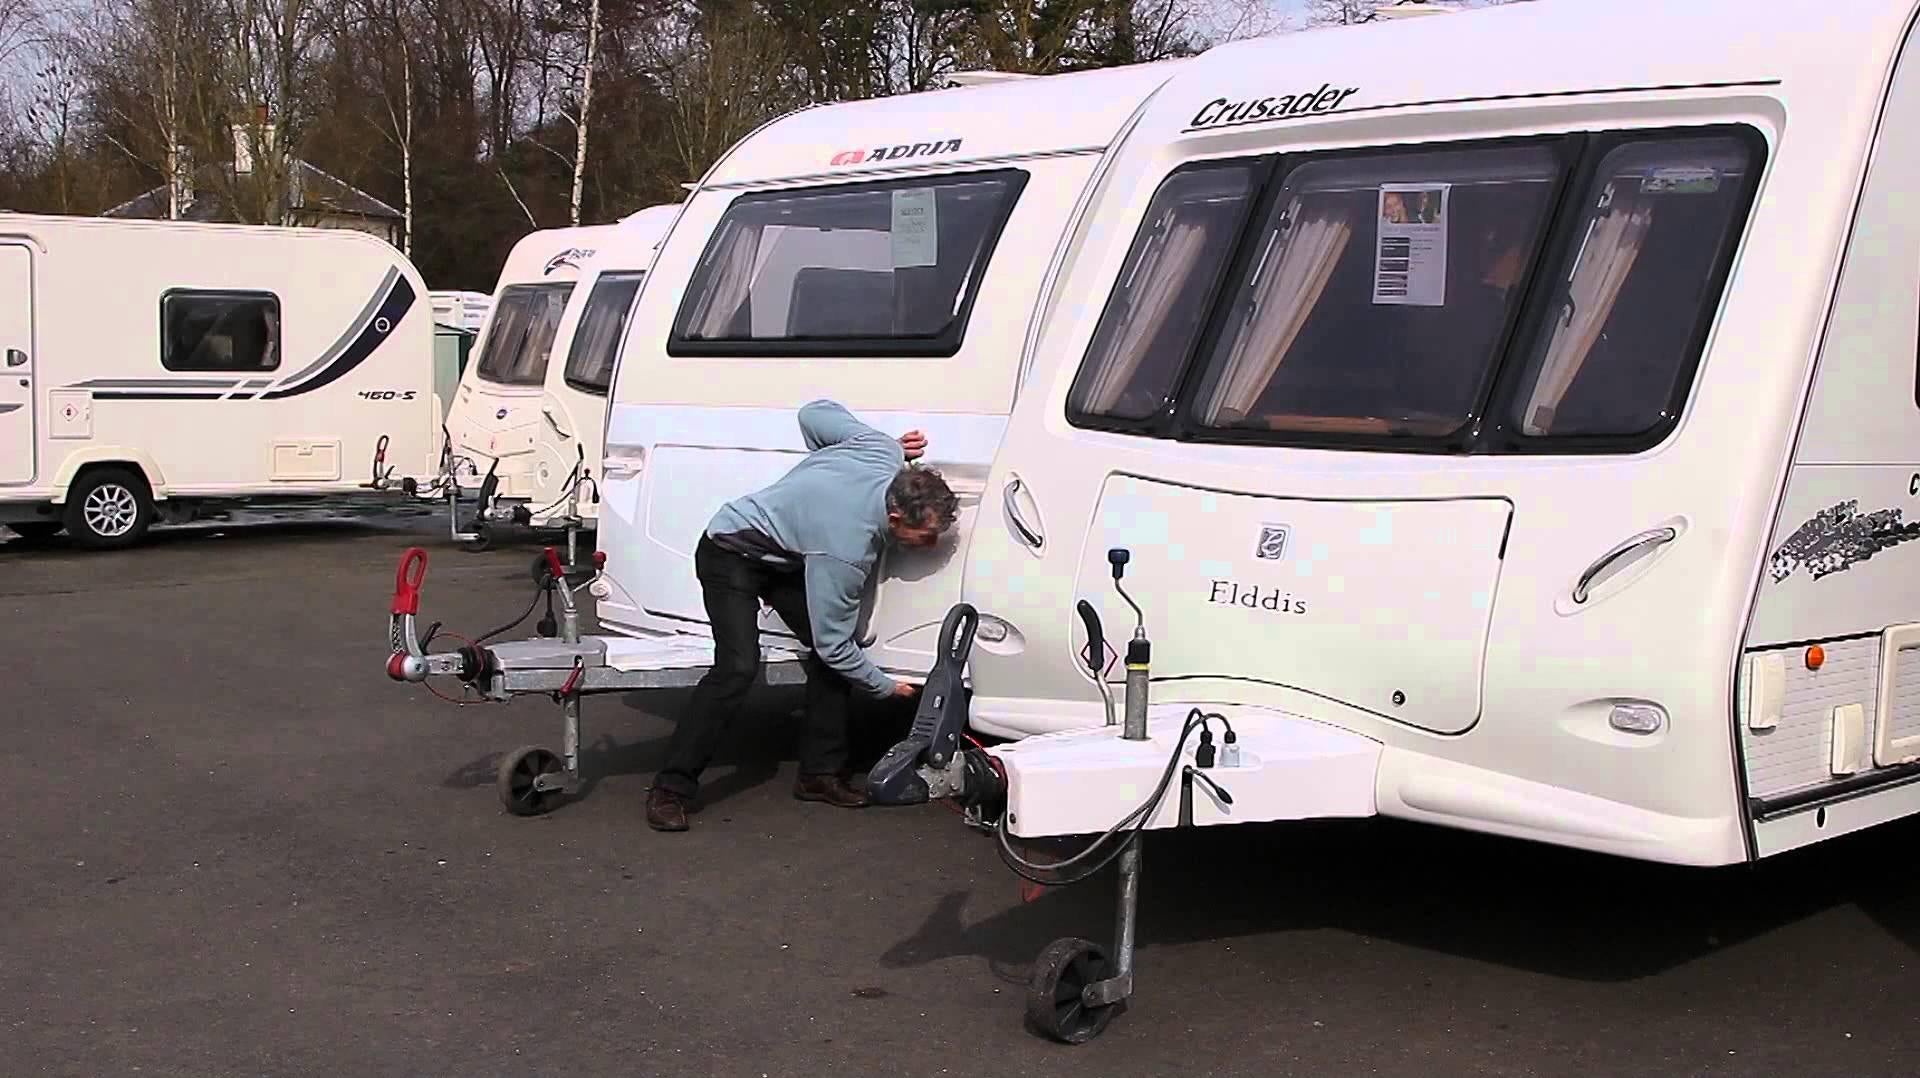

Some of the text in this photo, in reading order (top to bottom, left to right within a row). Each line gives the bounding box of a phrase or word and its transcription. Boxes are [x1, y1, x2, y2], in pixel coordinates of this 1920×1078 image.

[1190, 83, 1360, 126] Crusader
[866, 138, 963, 162] ADRIA
[357, 390, 417, 400] 460-S
[1208, 579, 1307, 614] Elddis
